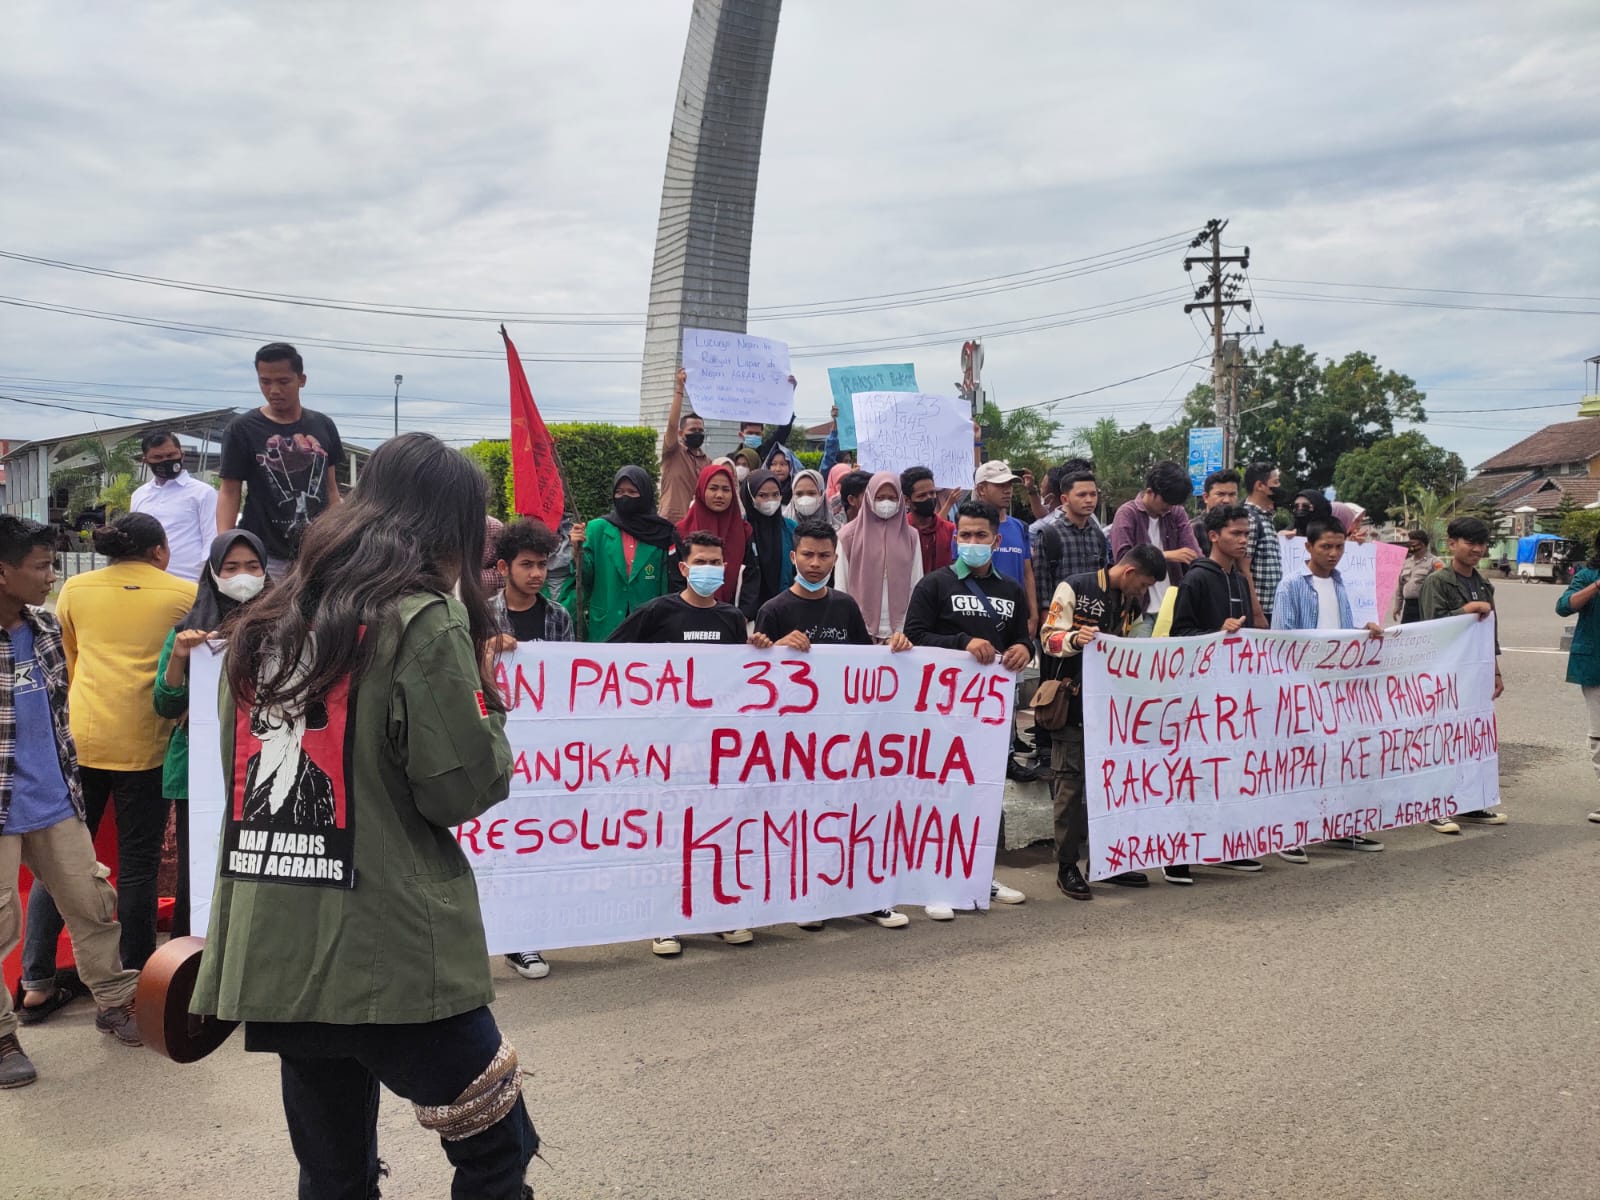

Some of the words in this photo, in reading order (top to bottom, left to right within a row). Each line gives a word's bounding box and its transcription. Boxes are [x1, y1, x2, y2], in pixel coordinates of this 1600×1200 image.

[1221, 636, 1311, 675] TAHUN
[570, 657, 713, 714] PASAL
[738, 659, 819, 716] 33
[844, 665, 899, 705] UUD
[914, 662, 1009, 726] 1945
[1109, 687, 1262, 756] NEGARA
[1274, 677, 1384, 736] MENJAMIN
[1386, 672, 1459, 720] PANGAN
[709, 727, 976, 788] PANCASILA
[1101, 756, 1232, 811] RAKYAT
[1239, 743, 1328, 797] SAMPAI
[1339, 736, 1372, 785] KE
[1378, 711, 1498, 780] PERSEORANGAN
[264, 854, 344, 881] AGRARIS
[270, 832, 326, 855] HABIS
[680, 799, 981, 921] KEMISKINAN
